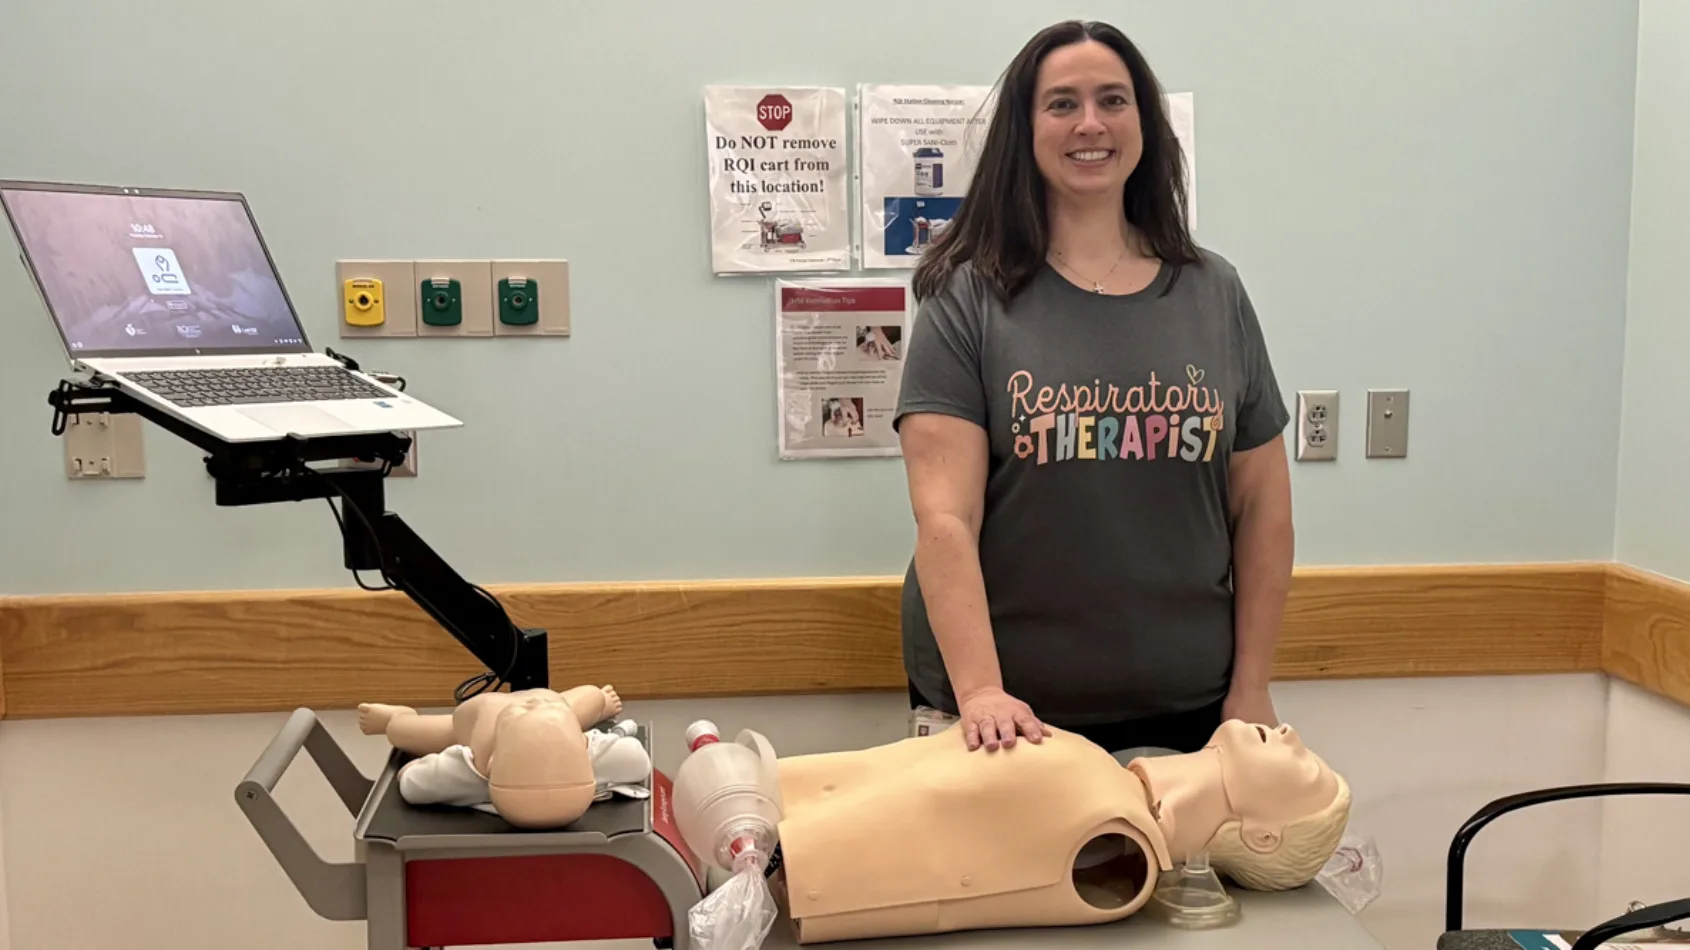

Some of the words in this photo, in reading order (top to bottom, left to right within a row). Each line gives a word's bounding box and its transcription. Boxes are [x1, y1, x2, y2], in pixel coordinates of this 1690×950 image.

[759, 105, 791, 120] STOP
[716, 136, 737, 149] Do
[741, 136, 778, 149] NOT
[783, 139, 837, 149] remove
[724, 158, 755, 174] RQI
[760, 161, 789, 171] cart
[794, 158, 830, 171] from
[730, 180, 757, 193] this
[761, 180, 824, 193] location!
[1007, 370, 1224, 430] Respiratory
